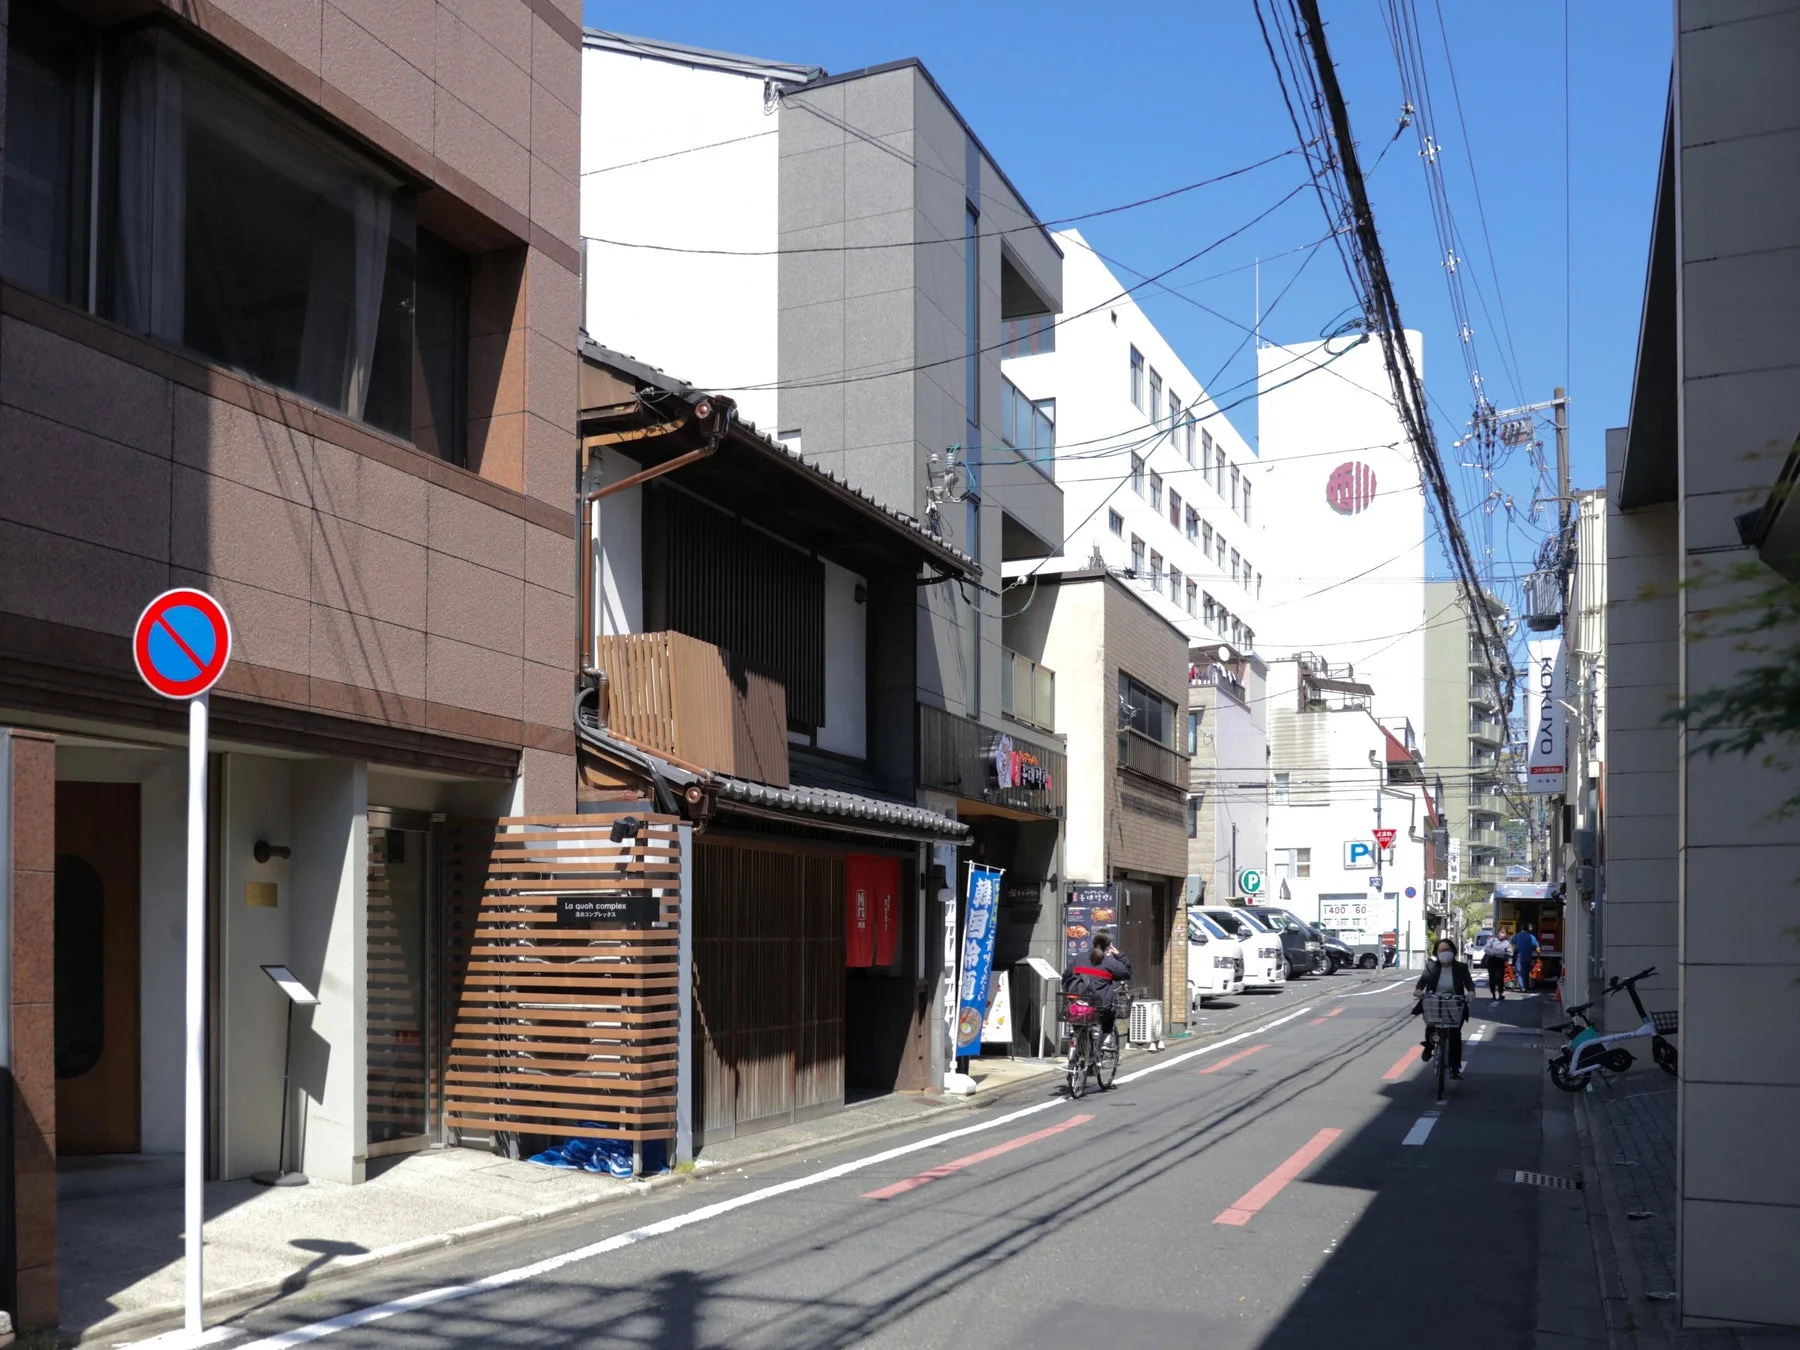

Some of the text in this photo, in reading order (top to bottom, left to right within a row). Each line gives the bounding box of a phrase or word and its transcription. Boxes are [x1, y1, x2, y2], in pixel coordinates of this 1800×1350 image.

[1540, 657, 1553, 755] KOKUYO
[1350, 843, 1370, 863] P
[1247, 873, 1260, 890] P
[595, 902, 626, 911] complex
